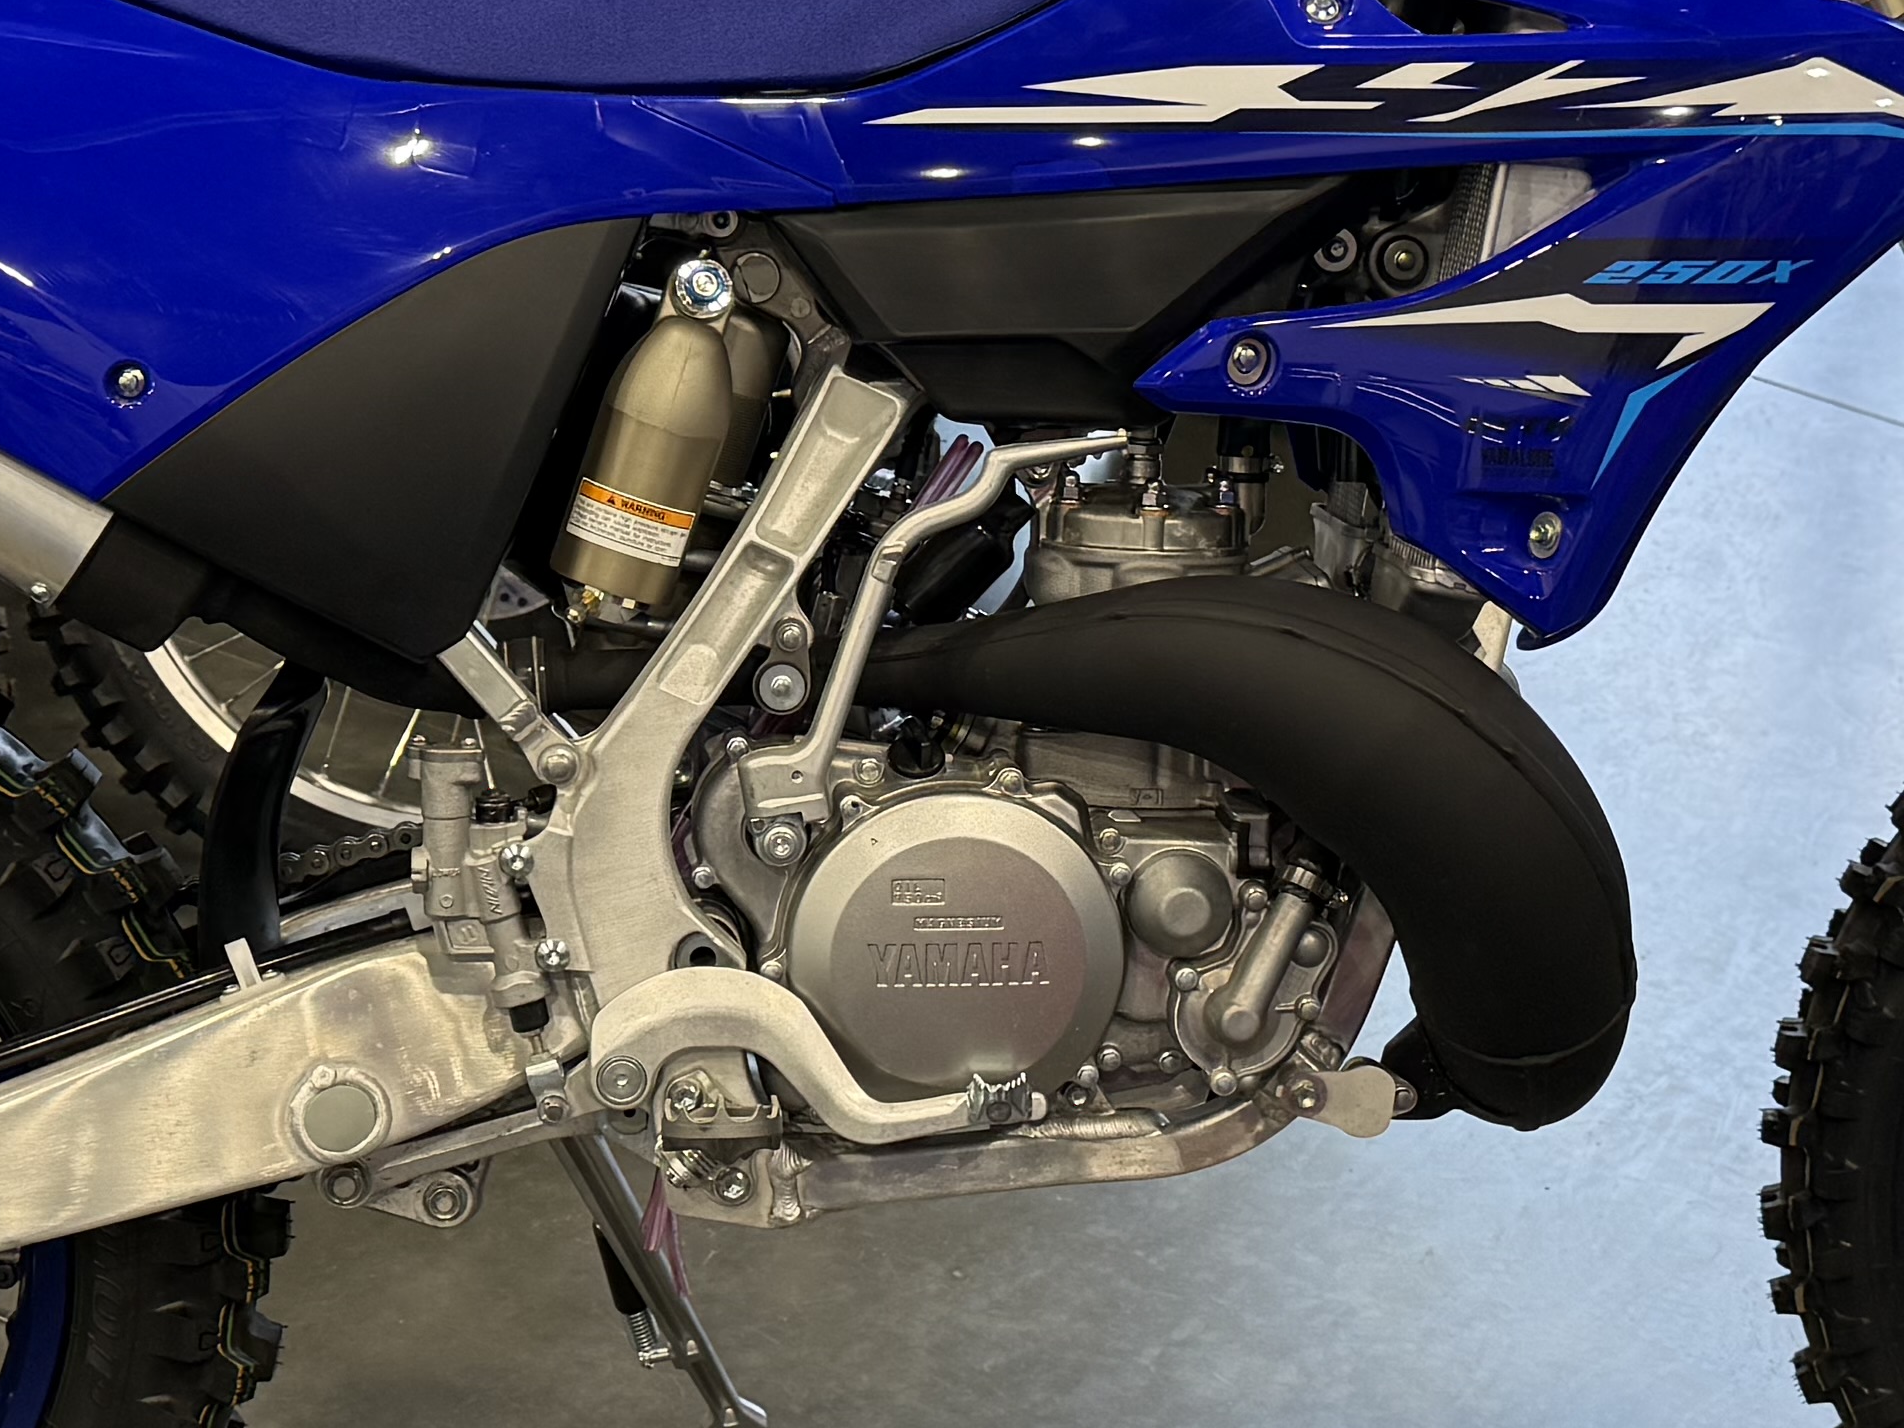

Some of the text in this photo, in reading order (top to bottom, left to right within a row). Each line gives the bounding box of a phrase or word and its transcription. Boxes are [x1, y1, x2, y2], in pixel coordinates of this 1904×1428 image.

[1582, 259, 1814, 285] 250X
[620, 498, 666, 521] WARNING
[867, 941, 1051, 988] YAMAHA
